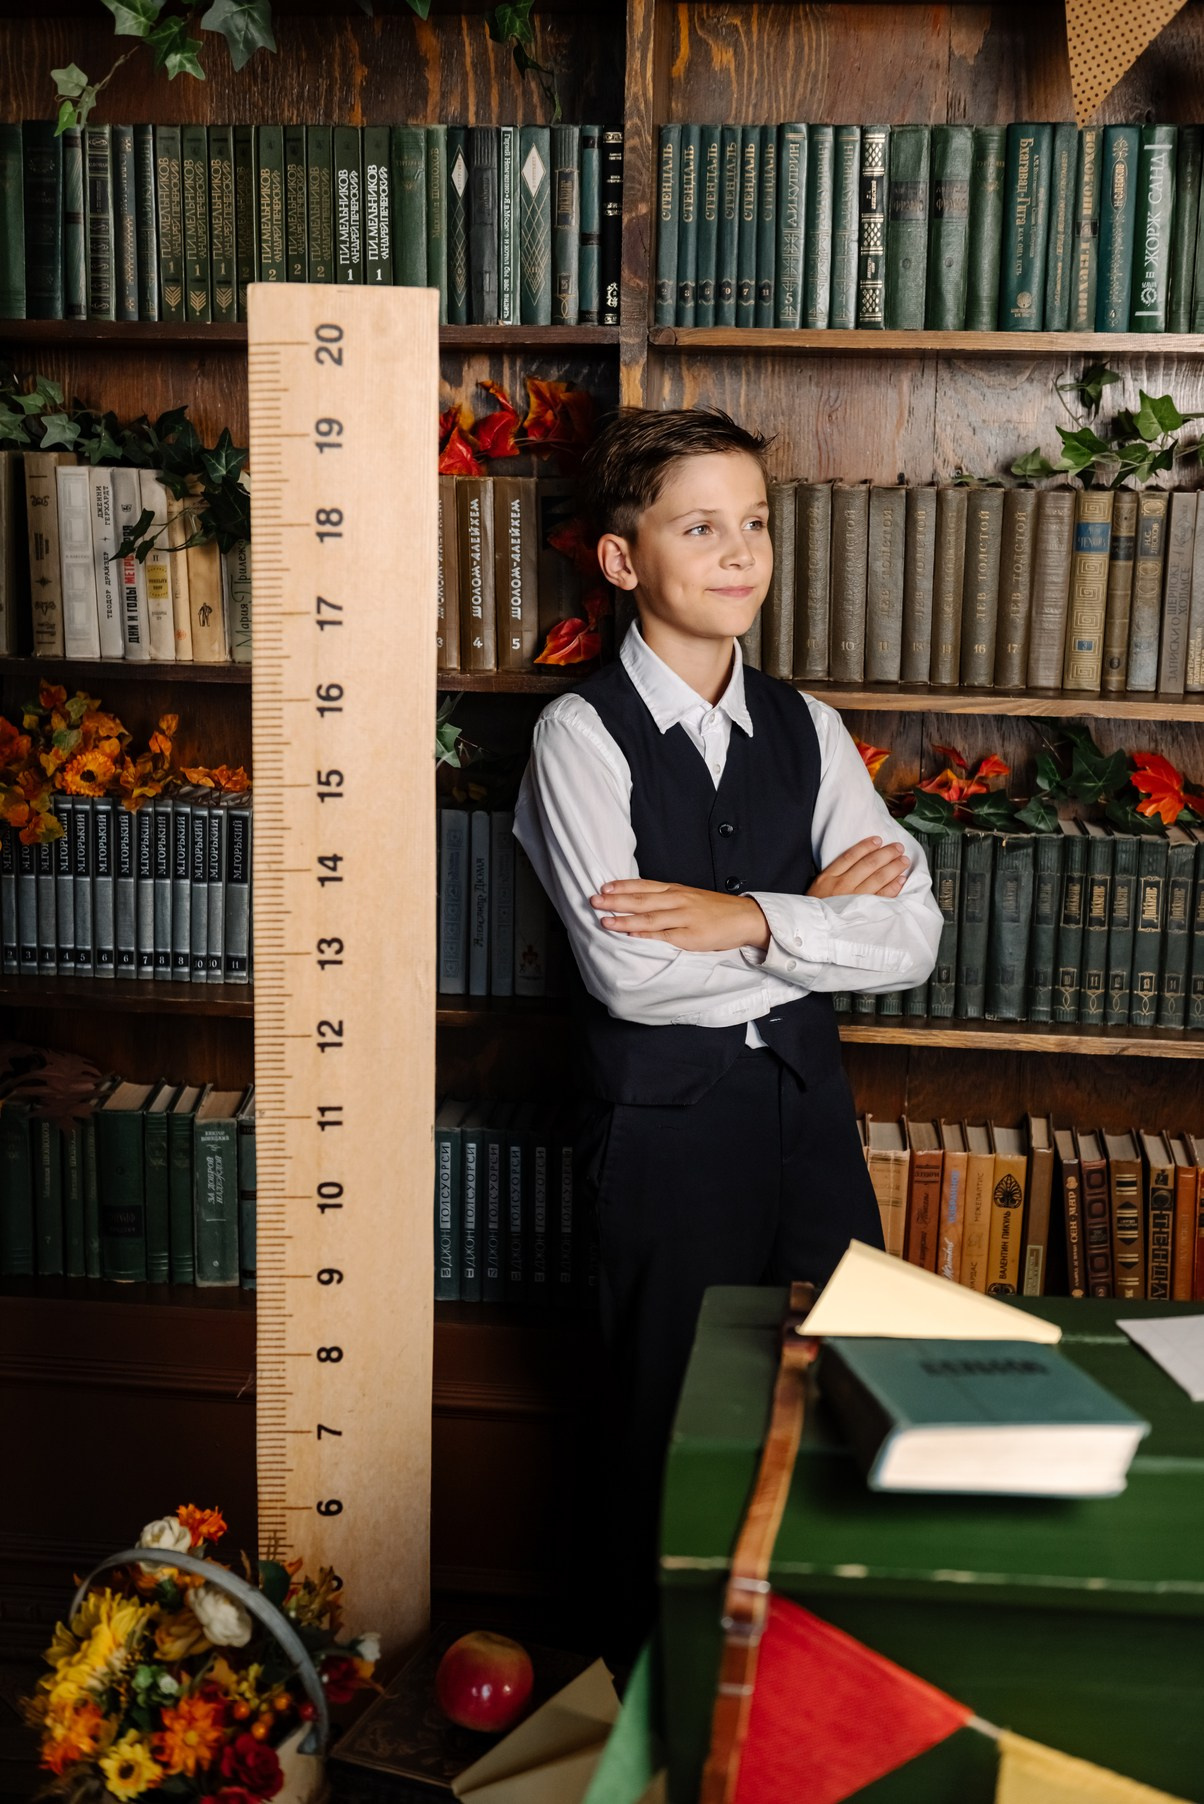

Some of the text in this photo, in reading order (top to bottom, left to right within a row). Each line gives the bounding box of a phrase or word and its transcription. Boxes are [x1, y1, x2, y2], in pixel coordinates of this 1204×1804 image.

[287, 164, 296, 231] МЕЛЬНИКОВ
[310, 166, 320, 238] МЕЛЬНИКОВ
[431, 148, 439, 199] ШОЛОХОВ
[662, 143, 675, 221] СТЕНДАЛЬ
[683, 145, 694, 222] СТЕНДАЛЬ
[705, 143, 720, 220] СТЕНДАЛЬ
[724, 142, 737, 219] СТЕНДАЛЬ
[743, 143, 755, 221] СТЕНДАЛЬ
[765, 144, 775, 221] СТЕНДАЛЬ
[1015, 137, 1034, 225] Бхагавад-Гита
[1148, 153, 1166, 204] САНД
[159, 158, 171, 258] П.И. МЕЛЬНИКОВ
[184, 159, 197, 260] П.И. МЕЛЬНИКОВ
[211, 159, 222, 259] П.И. МЕЛЬНИКОВ
[261, 169, 271, 263] П.И. МЕЛЬНИКОВ
[339, 169, 349, 264] П.И. МЕЛЬНИКОВ
[368, 165, 378, 260] П.И. МЕЛЬНИКОВ
[1144, 211, 1161, 267] ЖОРЖ
[785, 293, 793, 304] 5
[315, 324, 344, 366] 20
[315, 417, 344, 454] 19
[96, 486, 104, 518] ДЖЕННИ
[102, 486, 110, 525] ГЕРХАРДТ
[316, 506, 344, 544] 18
[102, 551, 113, 619] ТЕОДОР ДРАЙЗЕР
[469, 498, 482, 619] ШОЛОМ-АЛЕЙХЕМ
[509, 499, 521, 620] ШОЛОМ-АЛЕЙХЕМ
[977, 510, 990, 621] ЛЕВ ТОЛСТОЙ
[1010, 511, 1027, 620] ЛЕВ ТОЛСТОЙ
[125, 587, 138, 612] ГОДЫ
[316, 596, 344, 630] 17
[127, 624, 140, 644] ДНИ
[473, 637, 483, 649] 4
[512, 638, 520, 650] 5
[1168, 617, 1181, 682] ЗАПИСКИ О
[316, 682, 344, 717] 16
[317, 769, 344, 803] 15
[77, 814, 85, 872] М.ГОРЬКИЙ
[98, 814, 108, 872] М.ГОРЬКИЙ
[120, 815, 129, 873] М.ГОРЬКИЙ
[140, 816, 150, 875] М.ГОРЬКИЙ
[157, 816, 166, 875] М.ГОРЬКИЙ
[176, 816, 186, 875] М.ГОРЬКИЙ
[194, 819, 203, 878] М.ГОРЬКИЙ
[210, 819, 219, 878] М.ГОРЬКИЙ
[233, 820, 243, 879] М.ГОРЬКИЙ
[317, 854, 344, 887] 14
[81, 953, 86, 962] 5
[102, 954, 108, 962] 6
[123, 954, 129, 962] 6
[142, 956, 148, 965] 7
[160, 956, 165, 964] 8
[178, 956, 184, 965] 8
[317, 936, 344, 970] 13
[317, 1020, 344, 1053] 12
[317, 1106, 344, 1132] 11
[206, 1156, 215, 1205] ЗА ДОБРОЙ
[214, 1155, 225, 1205] НАДЕЖДОЙ
[317, 1180, 344, 1214] 10
[440, 1145, 452, 1267] ДЖОН ГОЛСУОРСИ
[464, 1145, 476, 1267] ДЖОН ГОЛСУОРСИ
[489, 1147, 499, 1224] ГОЛСУОРСИ
[511, 1150, 520, 1228] ГОЛСУОРСИ
[998, 1211, 1011, 1280] ВАЛЕНТИН ПИКУЛЬ
[317, 1268, 344, 1286] 9
[317, 1346, 344, 1364] 8
[317, 1423, 343, 1440] 7
[317, 1498, 344, 1516] 6
